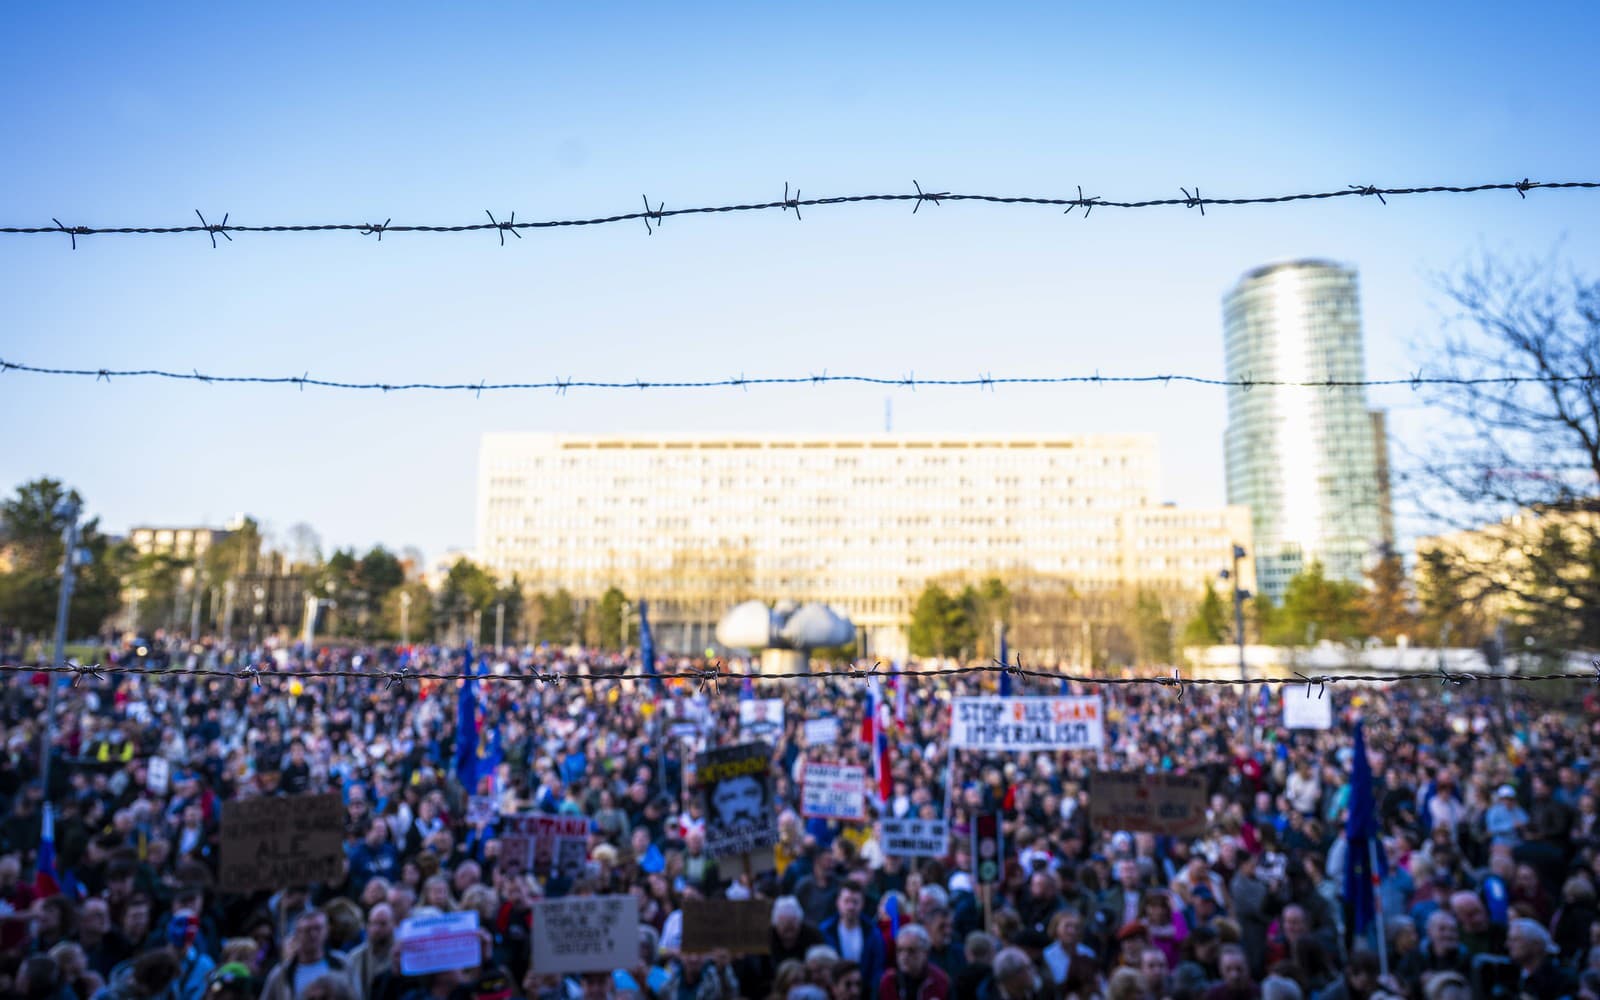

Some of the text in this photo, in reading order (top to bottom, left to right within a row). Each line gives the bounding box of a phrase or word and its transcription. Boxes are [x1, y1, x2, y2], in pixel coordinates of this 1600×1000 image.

[959, 702, 1097, 722] STOP RUSSIAN
[966, 723, 1089, 744] IMPERIALISM
